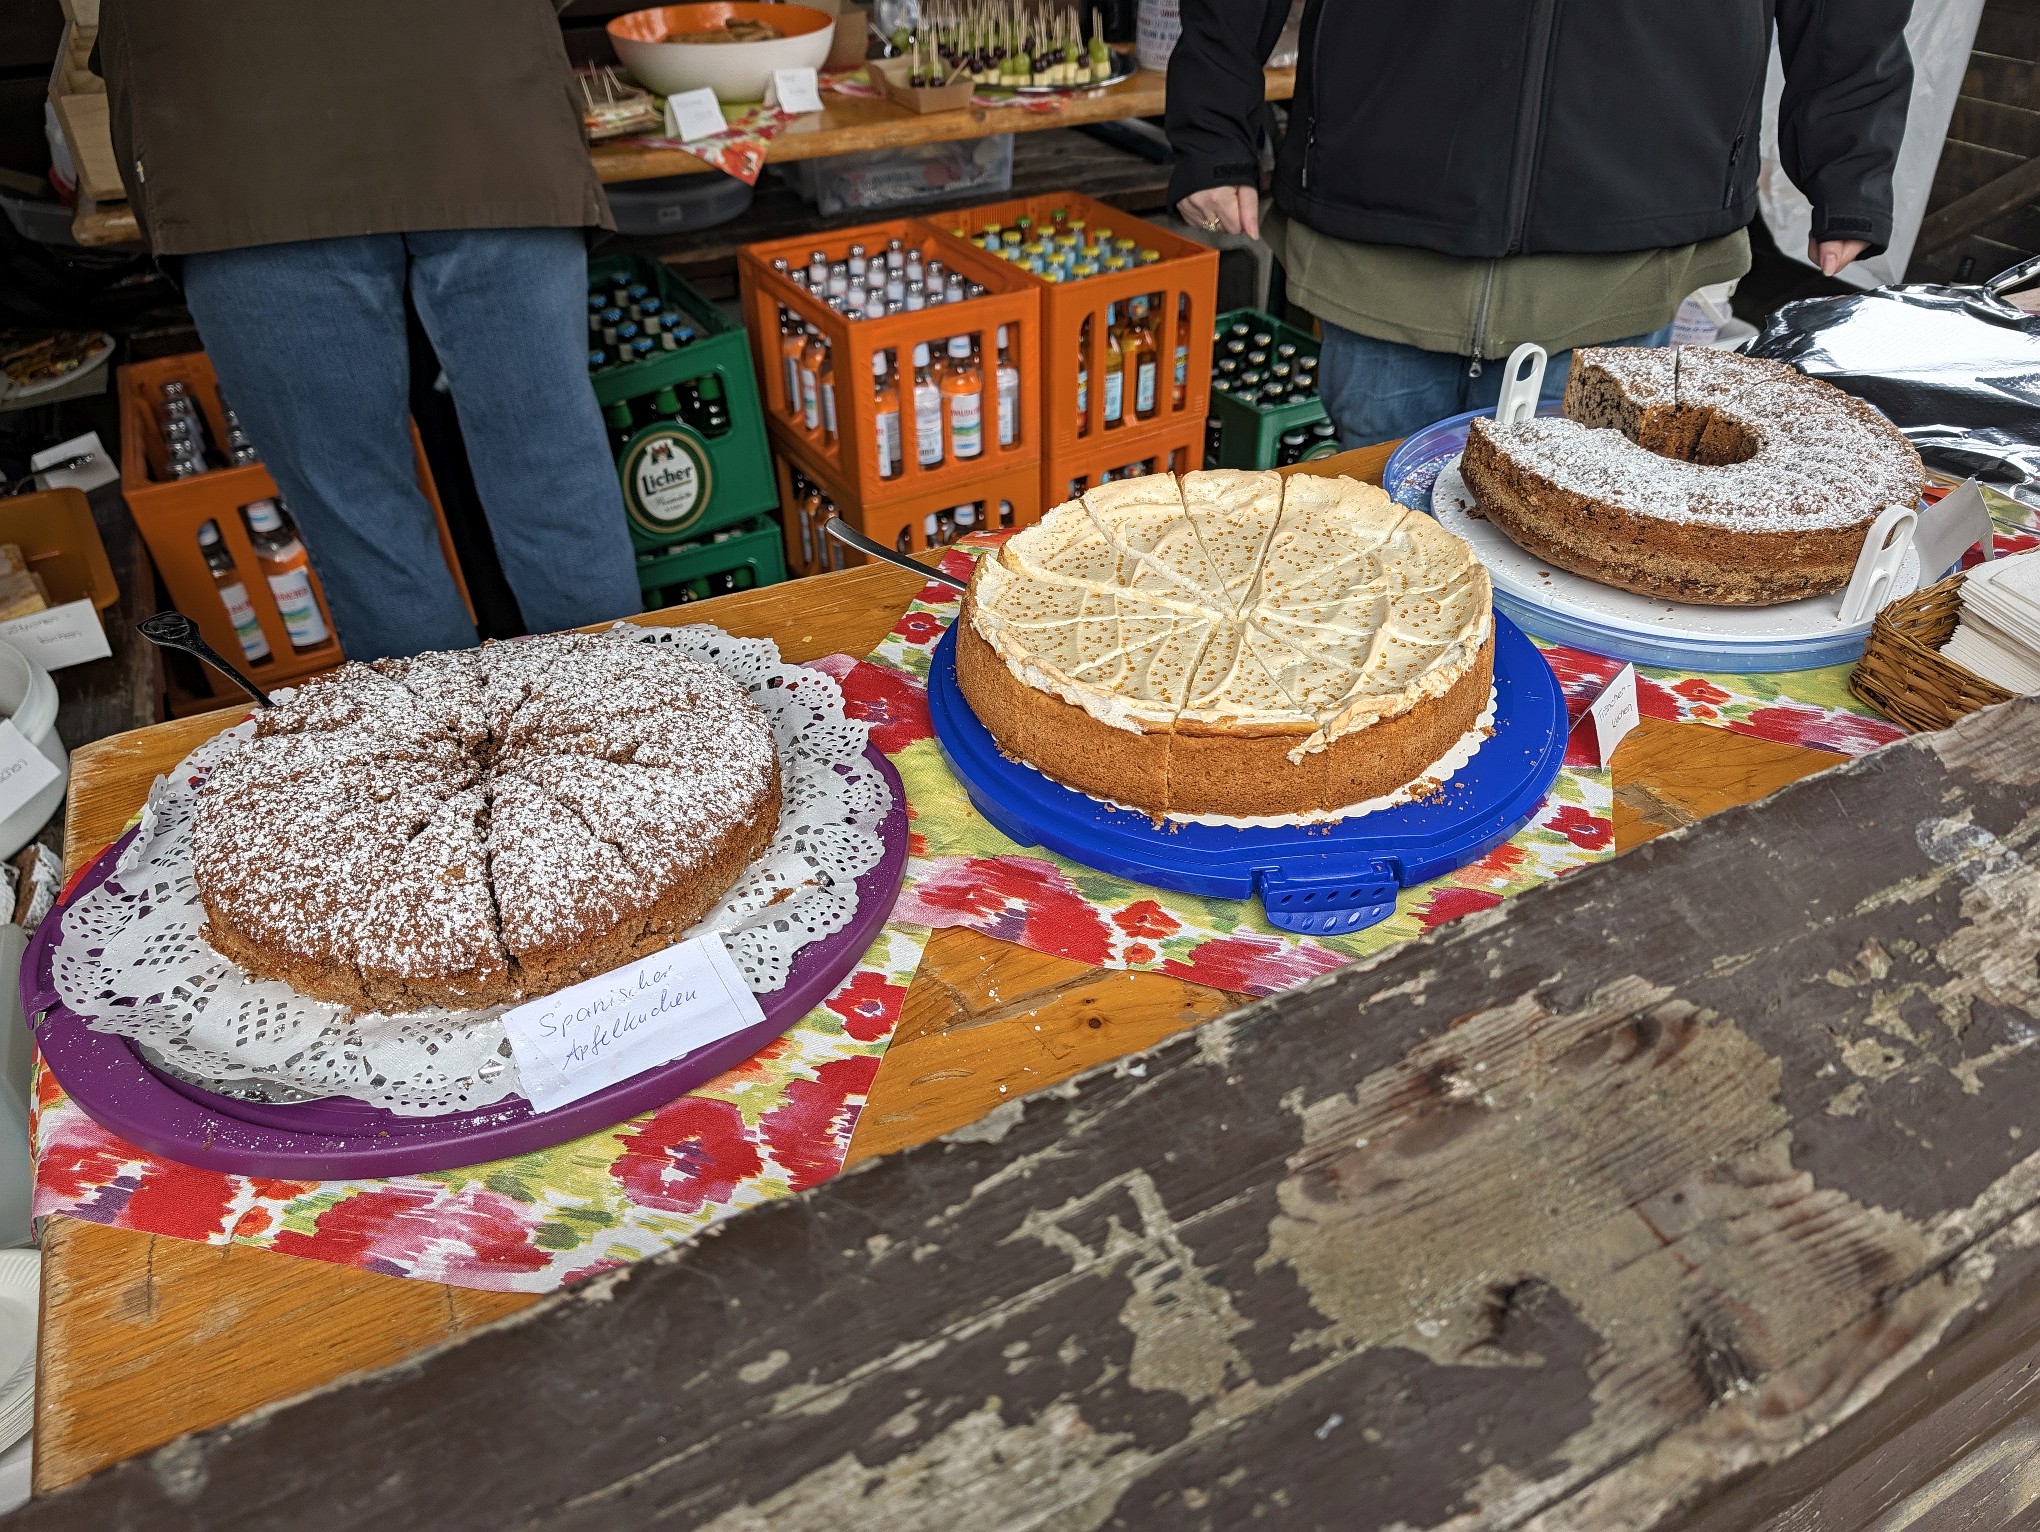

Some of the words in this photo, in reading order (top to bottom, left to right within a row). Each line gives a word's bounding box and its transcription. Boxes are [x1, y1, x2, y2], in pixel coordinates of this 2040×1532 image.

[642, 466, 692, 497] Licher
[539, 964, 675, 1038] Spanischer
[562, 988, 698, 1071] Apfelkuchen
